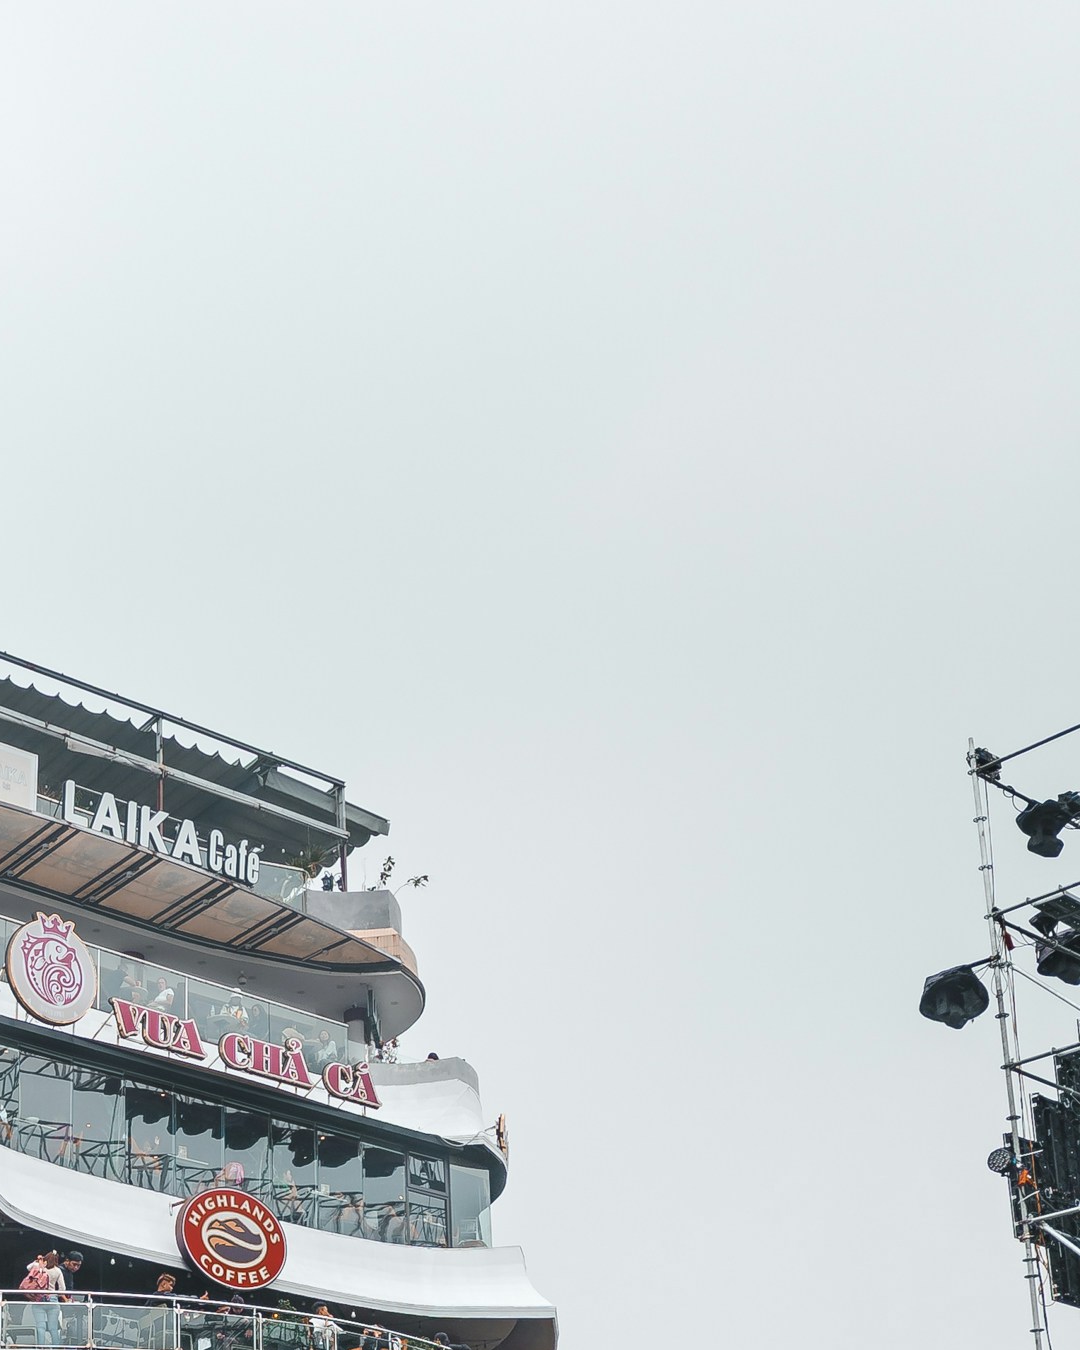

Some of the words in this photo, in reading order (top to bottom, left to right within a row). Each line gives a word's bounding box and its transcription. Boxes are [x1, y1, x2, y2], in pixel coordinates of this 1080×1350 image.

[63, 779, 204, 869] LAIKA
[207, 829, 261, 887] Café
[110, 997, 206, 1060] VUA
[217, 1032, 313, 1090] CHẢ
[322, 1059, 382, 1109] CÁ
[188, 1194, 280, 1245] HIGHLANDS
[200, 1254, 271, 1285] COFFEE
